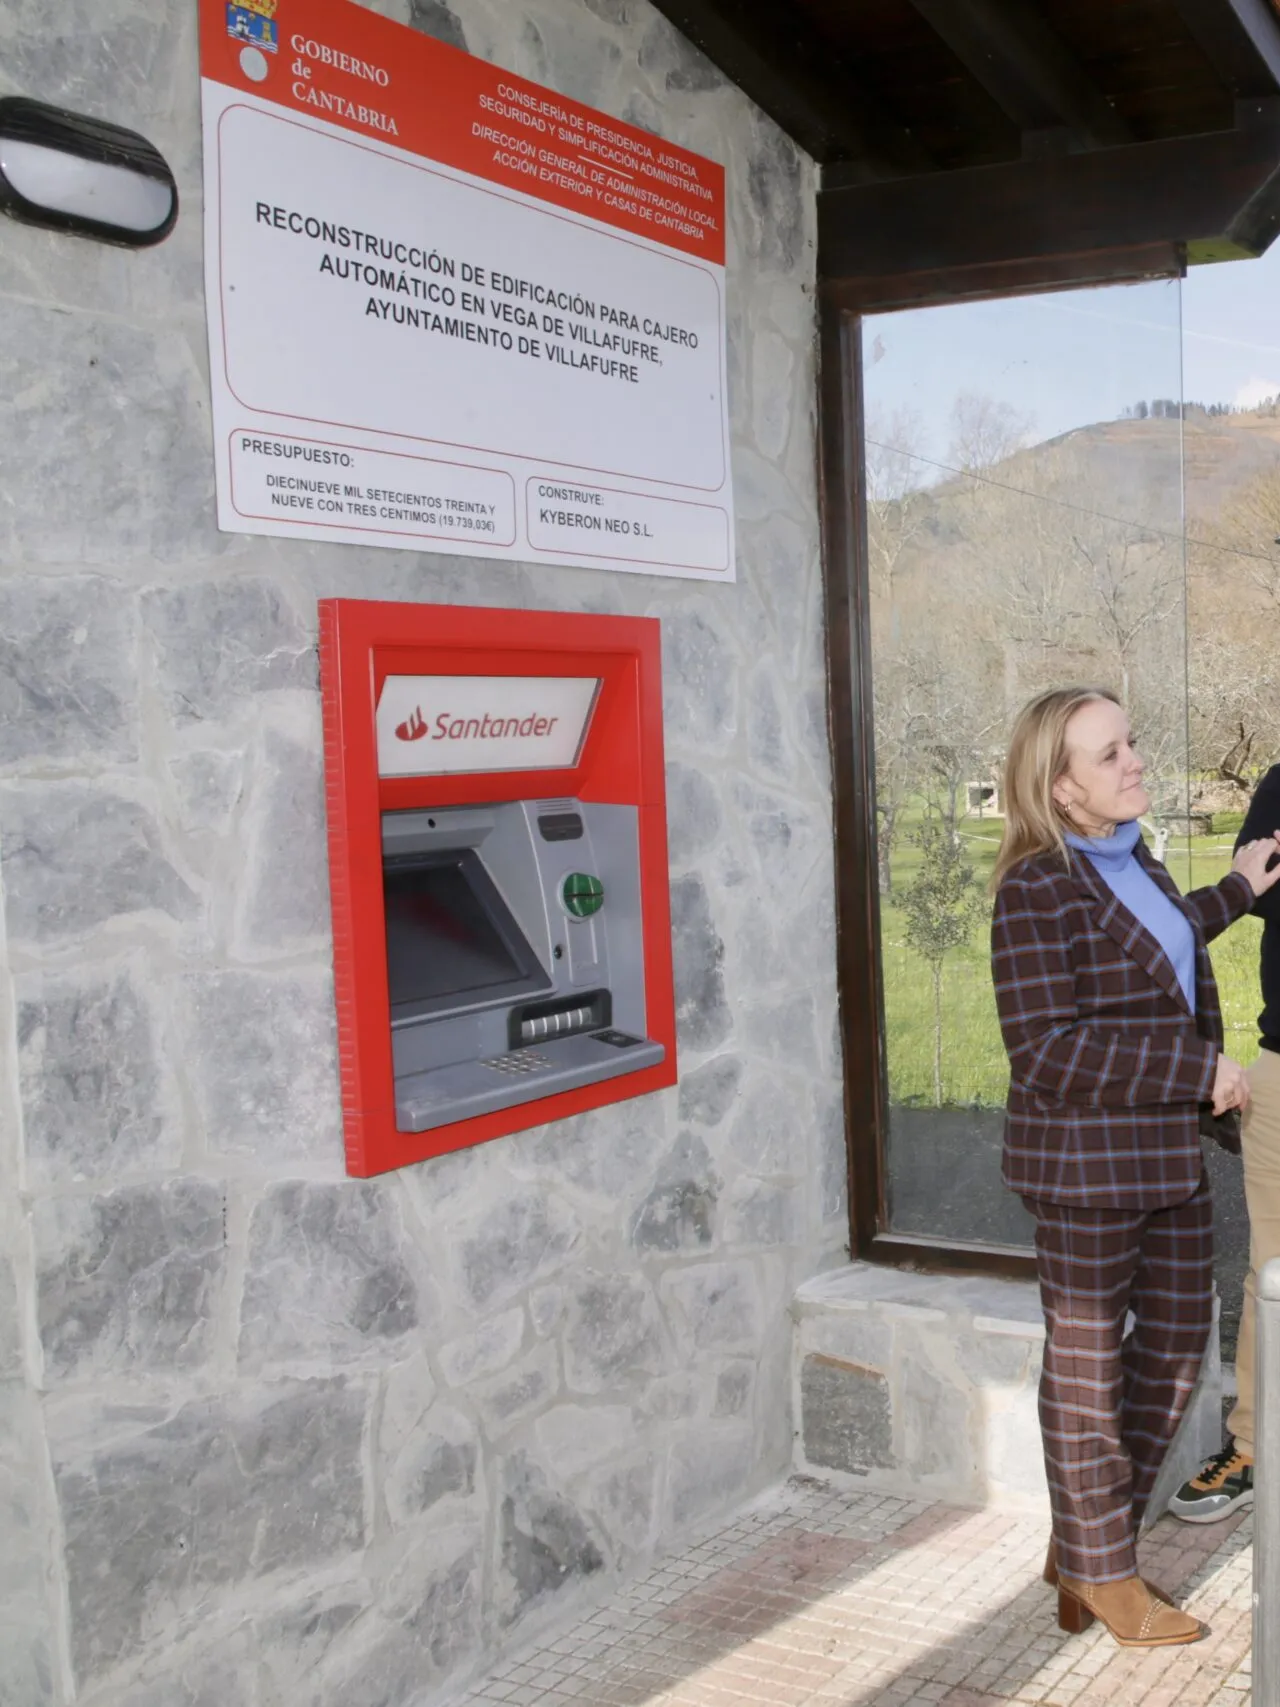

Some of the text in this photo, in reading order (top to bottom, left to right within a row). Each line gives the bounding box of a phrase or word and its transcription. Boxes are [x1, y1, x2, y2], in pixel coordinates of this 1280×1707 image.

[291, 34, 389, 87] GOBIERNO
[291, 58, 312, 79] de
[292, 81, 399, 136] CANTABRIA
[497, 83, 567, 123] CONSEJERÍA
[569, 114, 584, 131] DE
[472, 122, 536, 157] DIRECCIÓN
[538, 149, 588, 178] GENERAL
[591, 169, 605, 185] DE
[607, 177, 688, 217] ADMINISTRACIÓN
[479, 94, 713, 202] SEGURIDAD Y SIMPLIFICACIÓN ADMINISTRATIVA
[493, 150, 704, 240] ACCIÓN EXTERIOR Y CASAS DE CANTABRIA
[256, 201, 699, 350] RECONSTRUCCIÓN DE EDIFICACIÓN PARA CAJERO
[319, 254, 663, 367] AUTOMÁTICO EN VEGA DE VILLAFUFRE,
[365, 297, 639, 383] AYUNTAMIENTO DE VILLAFUFRE
[242, 438, 354, 468] PRESUPUESTO:
[266, 474, 495, 516] DIECINUEVE MIL SETECIENTOS TREINTA Y
[271, 493, 495, 534] NUEVE CON TRES CENTIMOS (19.739,03€)
[538, 485, 604, 506] CONSTRUYE:
[540, 508, 654, 538] KYBERON NEO S.L.
[432, 712, 558, 740] Santander
